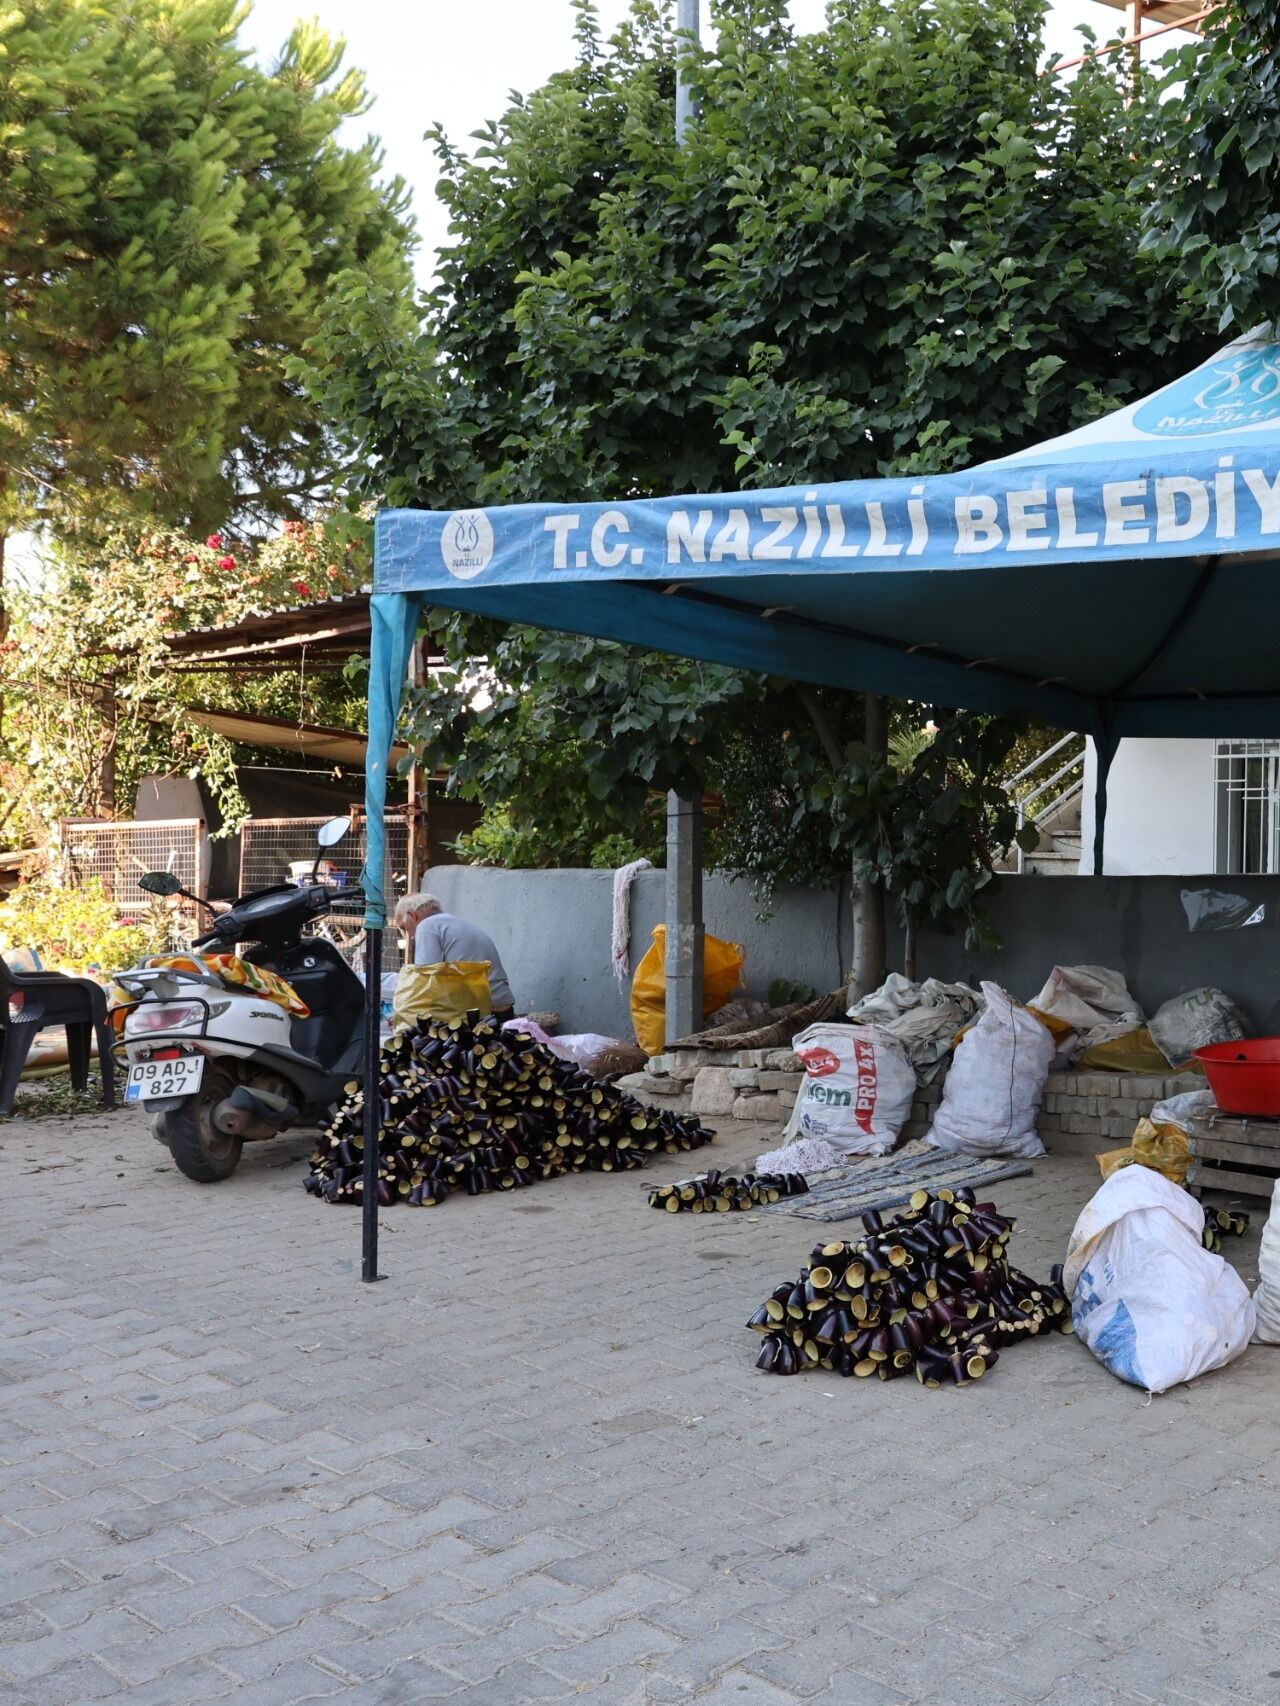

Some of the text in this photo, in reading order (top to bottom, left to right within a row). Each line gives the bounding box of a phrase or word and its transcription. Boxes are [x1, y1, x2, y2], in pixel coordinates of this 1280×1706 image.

[543, 511, 644, 569] T.C.
[666, 485, 929, 564] NAZİLLİ
[133, 1064, 157, 1081] 09
[151, 1078, 187, 1095] 827
[857, 1075, 877, 1111] PRO
